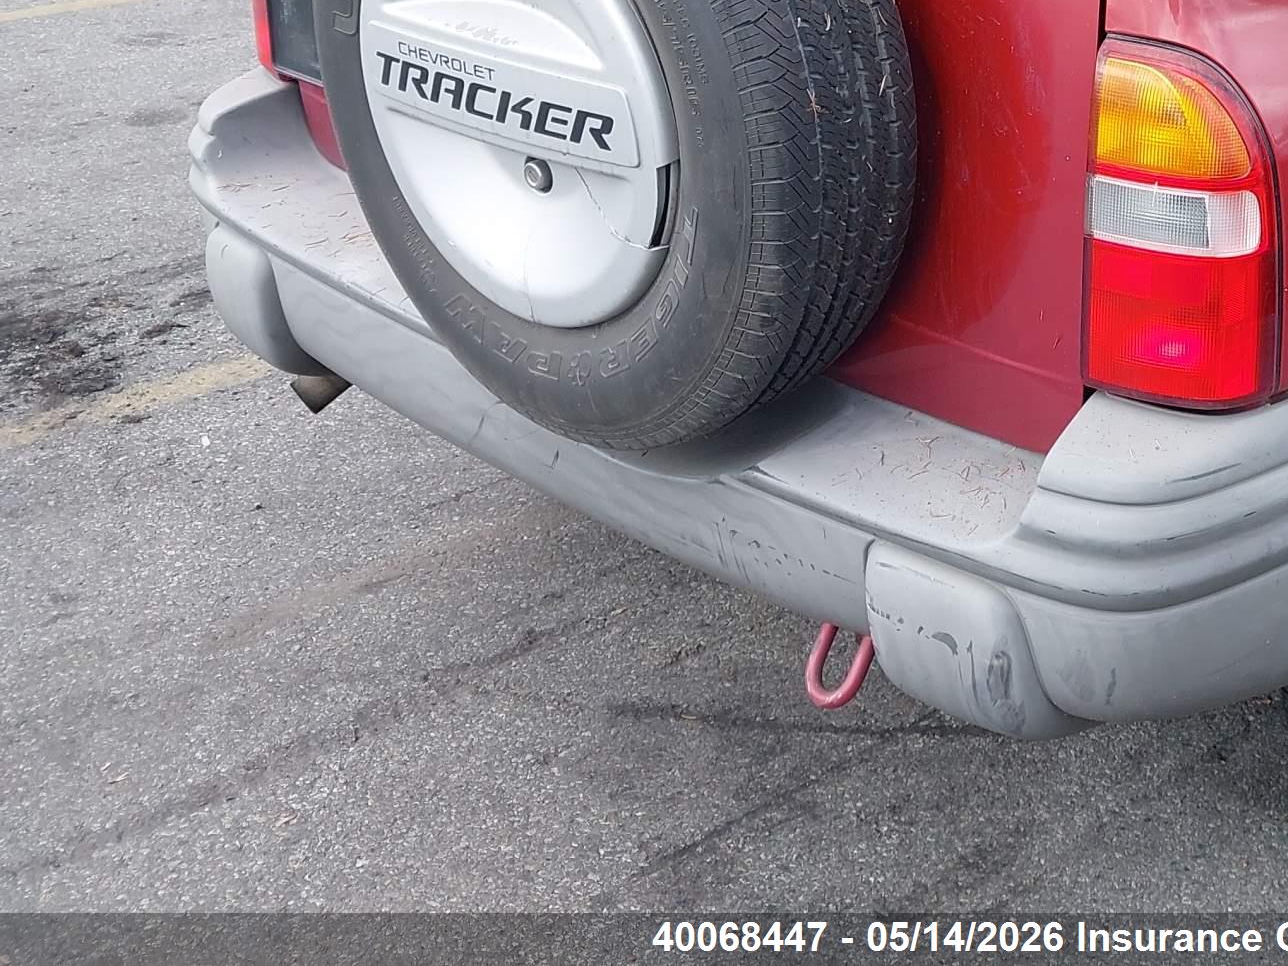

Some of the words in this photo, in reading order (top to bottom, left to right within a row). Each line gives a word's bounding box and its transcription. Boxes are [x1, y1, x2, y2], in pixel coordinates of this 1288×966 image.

[375, 50, 614, 152] TRACKER
[398, 41, 495, 81] CHEVROLET
[444, 293, 563, 380] PAW
[600, 207, 698, 378] TIGER
